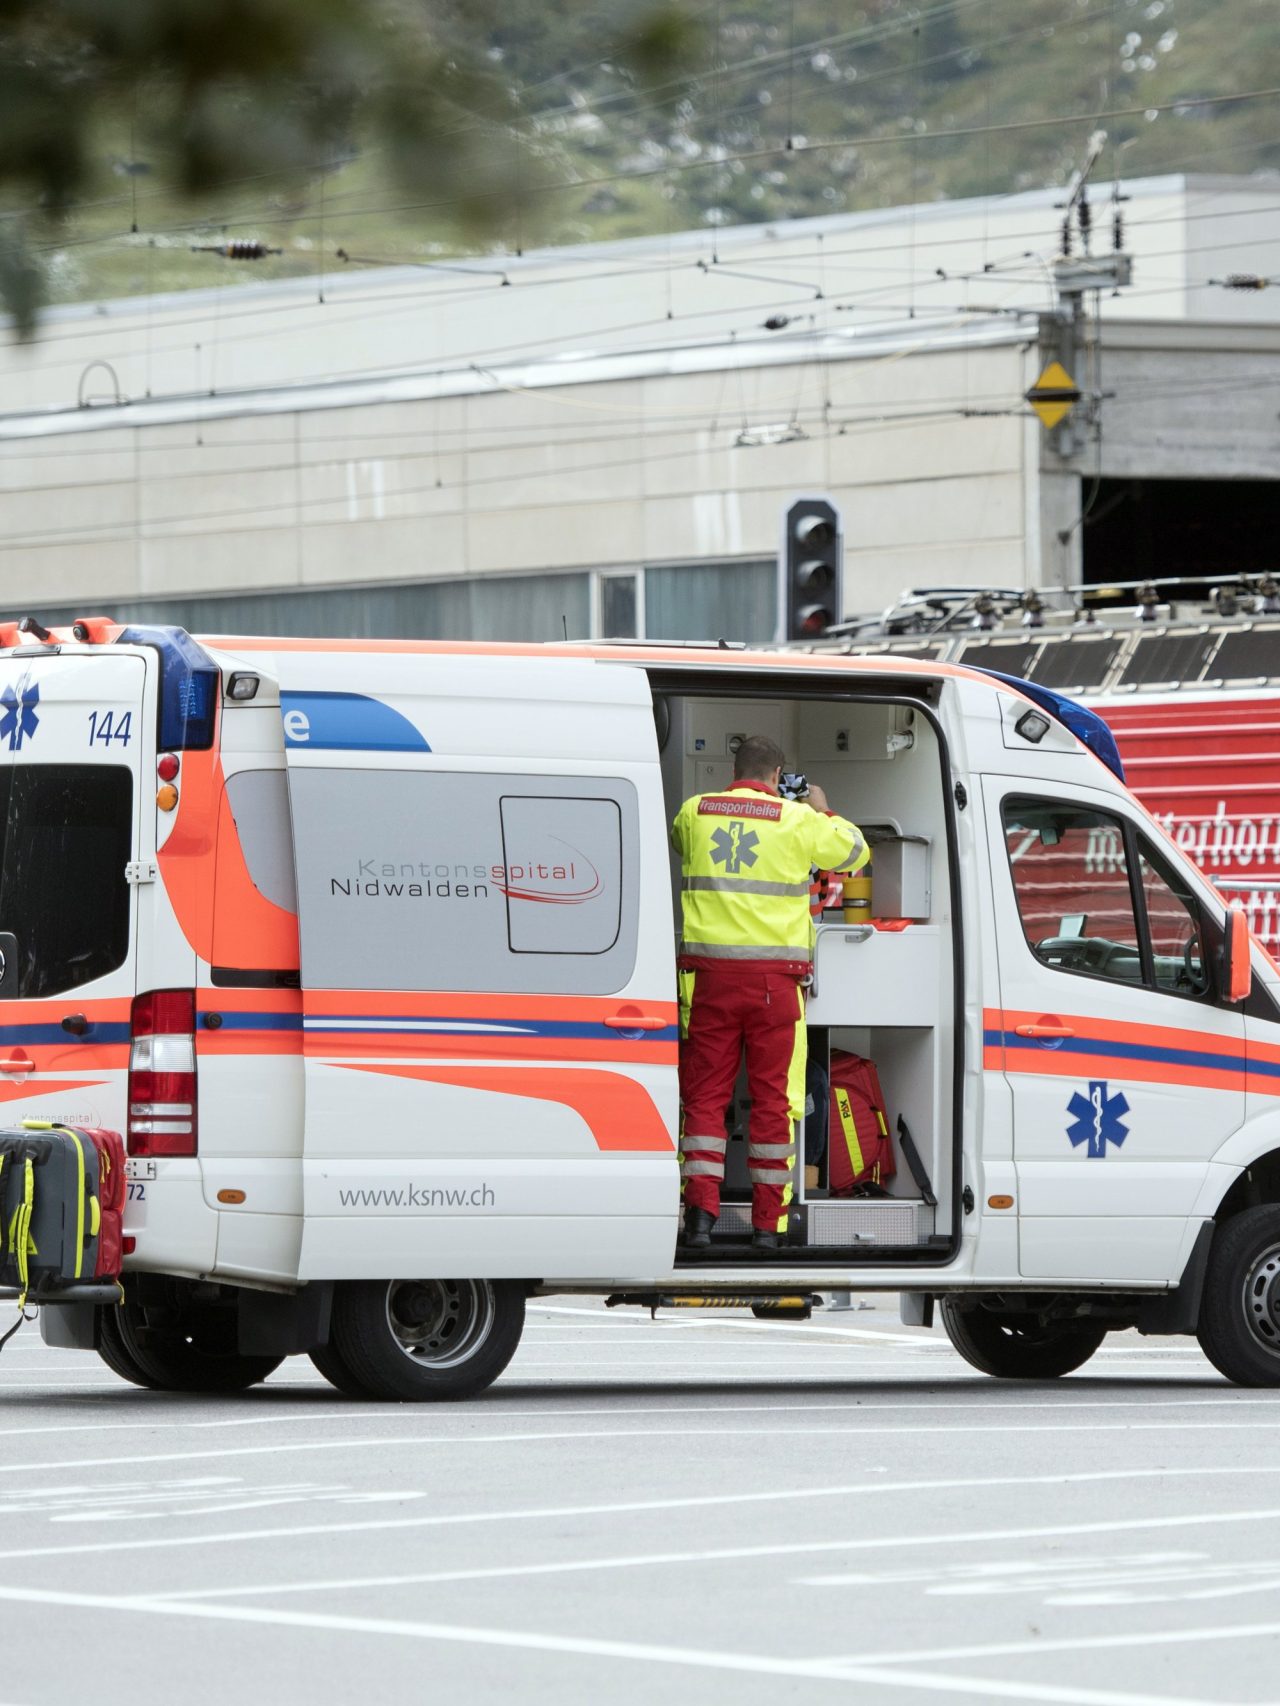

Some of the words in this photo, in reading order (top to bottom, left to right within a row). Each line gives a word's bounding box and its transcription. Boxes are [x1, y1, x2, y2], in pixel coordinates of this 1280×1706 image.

[87, 710, 132, 748] 144
[699, 800, 780, 817] Transporthelfer
[358, 858, 576, 882] Kantonsspital
[330, 878, 488, 898] Nidwalden
[127, 1183, 146, 1201] 72
[339, 1182, 495, 1206] www.ksnw.ch
